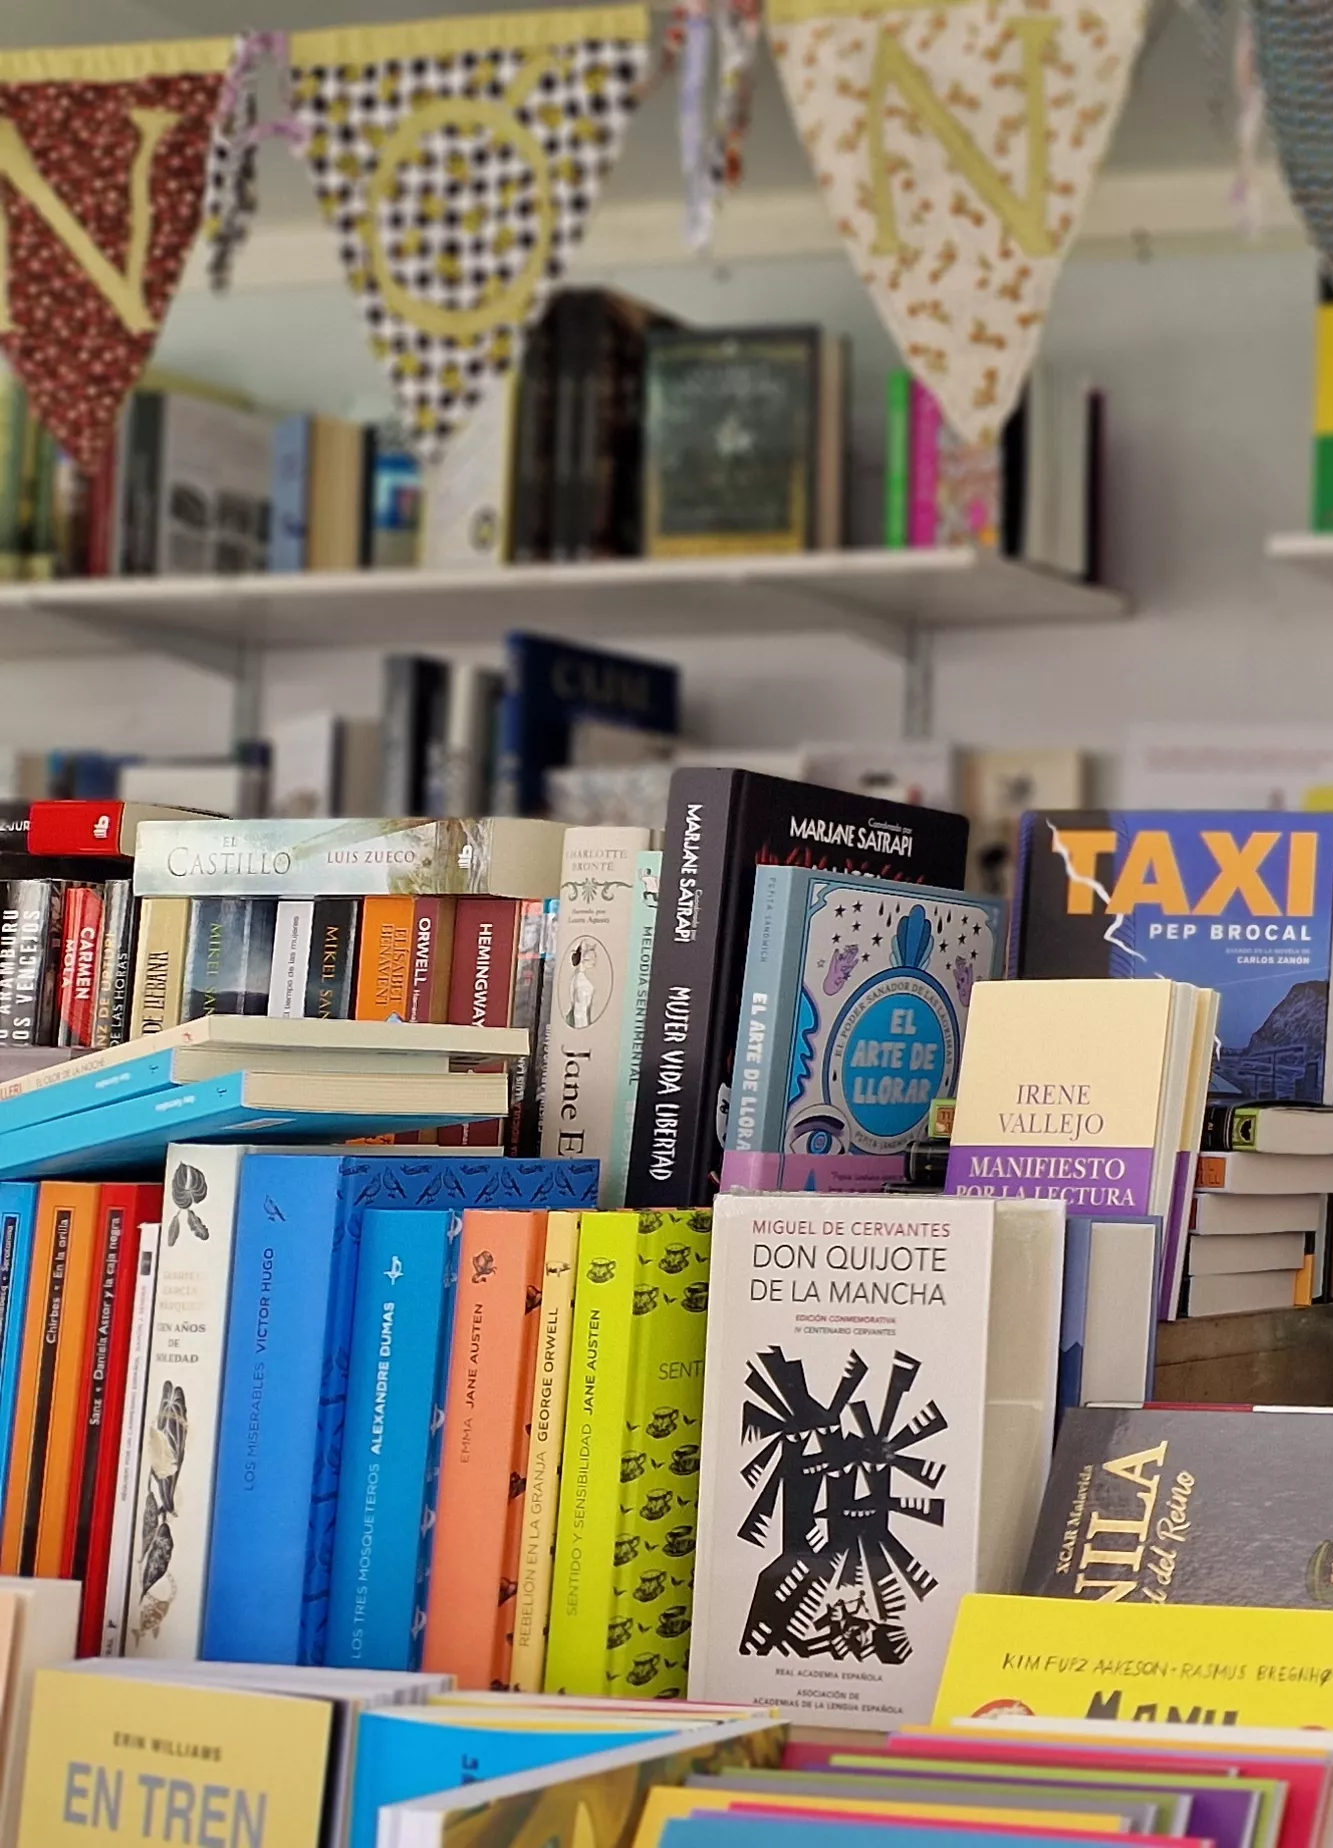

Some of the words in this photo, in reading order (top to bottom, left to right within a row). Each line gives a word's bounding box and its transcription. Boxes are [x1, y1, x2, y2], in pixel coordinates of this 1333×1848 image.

[222, 836, 237, 848] EL
[682, 804, 704, 875] MARJANE
[789, 815, 855, 847] MARJANE
[857, 830, 913, 858] SATRAPI
[167, 847, 292, 877] CASTILLO
[327, 850, 359, 864] LUIS
[364, 849, 416, 864] ZUECO
[1051, 830, 1318, 917] TAXI
[674, 879, 698, 943] SATRAPI
[1149, 923, 1197, 940] PEP
[1209, 924, 1312, 941] BROCAL
[206, 923, 223, 976] MIKEL
[290, 916, 299, 950] mujeres
[321, 926, 339, 983] MIKEL
[414, 917, 431, 987] ORWELL
[0, 909, 19, 1015] ARAMBURU
[15, 909, 41, 1004] VENCEJOS
[61, 939, 77, 988] MOLA
[76, 927, 95, 999] CARMEN
[114, 952, 128, 1000] HORAS
[472, 923, 493, 1028] HEMINGWAY
[1237, 956, 1274, 965] CARLOS
[112, 1003, 123, 1028] LAS
[663, 986, 692, 1043] MUJER
[750, 992, 768, 1016] EL
[890, 1008, 918, 1035] EL
[629, 989, 649, 1087] SENTIMENTAL
[745, 1019, 766, 1063] ARTE
[851, 1039, 907, 1071] ARTE
[909, 1043, 939, 1071] DE
[560, 1044, 592, 1121] Jane
[657, 1051, 685, 1096] VIDA
[742, 1068, 762, 1092] DE
[854, 1076, 931, 1106] LLORAR
[1016, 1084, 1091, 1105] IRENE
[648, 1102, 681, 1182] LIBERTAD
[998, 1112, 1104, 1141] VALLEJO
[969, 1155, 1126, 1181] MANIFIESTO
[1034, 1186, 1136, 1207] LECTURA
[58, 1219, 69, 1248] orilla
[109, 1217, 122, 1250] negra
[752, 1219, 817, 1238] MIGUEL
[823, 1220, 847, 1238] DE
[850, 1220, 950, 1239] CERVANTES
[53, 1264, 64, 1279] En
[56, 1251, 66, 1261] la
[106, 1253, 119, 1275] caja
[262, 1247, 275, 1292] HUGO
[752, 1243, 817, 1270] DON
[825, 1245, 948, 1274] QUIJOTE
[750, 1279, 784, 1303] DE
[791, 1280, 821, 1304] LA
[829, 1280, 946, 1306] MANCHA
[46, 1298, 60, 1344] Chirbes
[98, 1301, 112, 1335] Astor
[174, 1321, 206, 1333] AÑOS
[256, 1295, 270, 1354] VICTOR
[380, 1301, 396, 1357] DUMAS
[469, 1302, 483, 1365] AUSTEN
[586, 1308, 601, 1370] AUSTEN
[853, 1327, 897, 1336] CERVANTES
[93, 1337, 109, 1380] Daniela
[543, 1307, 560, 1373] ORWELL
[248, 1360, 265, 1457] MISERABLES
[370, 1360, 390, 1455] ALEXANDRE
[465, 1368, 477, 1410] JANE
[537, 1377, 554, 1443] GEORGE
[582, 1374, 596, 1417] JANE
[89, 1399, 103, 1426] Sanz
[459, 1416, 475, 1464] EMMA
[244, 1461, 257, 1492] LOS
[529, 1450, 547, 1515] GRANJA
[572, 1423, 592, 1529] SENSIBILIDAD
[1066, 1464, 1094, 1528] Malavida
[358, 1463, 380, 1582] MOSQUETEROS
[1155, 1470, 1196, 1542] Reino
[527, 1517, 540, 1539] LA
[526, 1542, 539, 1559] EN
[1055, 1530, 1079, 1575] XCAR
[566, 1546, 582, 1617] SENTIDO
[354, 1584, 368, 1625] TRES
[519, 1560, 537, 1647] REBELIÓN
[352, 1627, 363, 1659] LOS
[775, 1668, 795, 1677] REAL
[797, 1669, 839, 1679] ACADEMIA
[841, 1671, 884, 1682] ESPAÑOLA
[1002, 1653, 1042, 1671] KIM
[1092, 1659, 1168, 1681] AAKESON
[1180, 1662, 1247, 1681] RASMUS
[753, 1696, 800, 1709] ACADEMIAS
[826, 1702, 859, 1712] LENGUA
[861, 1703, 903, 1715] ESPAÑOLA
[797, 1688, 847, 1700] ASOCIACIÓN
[112, 1730, 146, 1752] ERIN
[149, 1733, 224, 1763] WILLIAMS
[63, 1760, 123, 1831] EN
[137, 1772, 268, 1848] TREN
